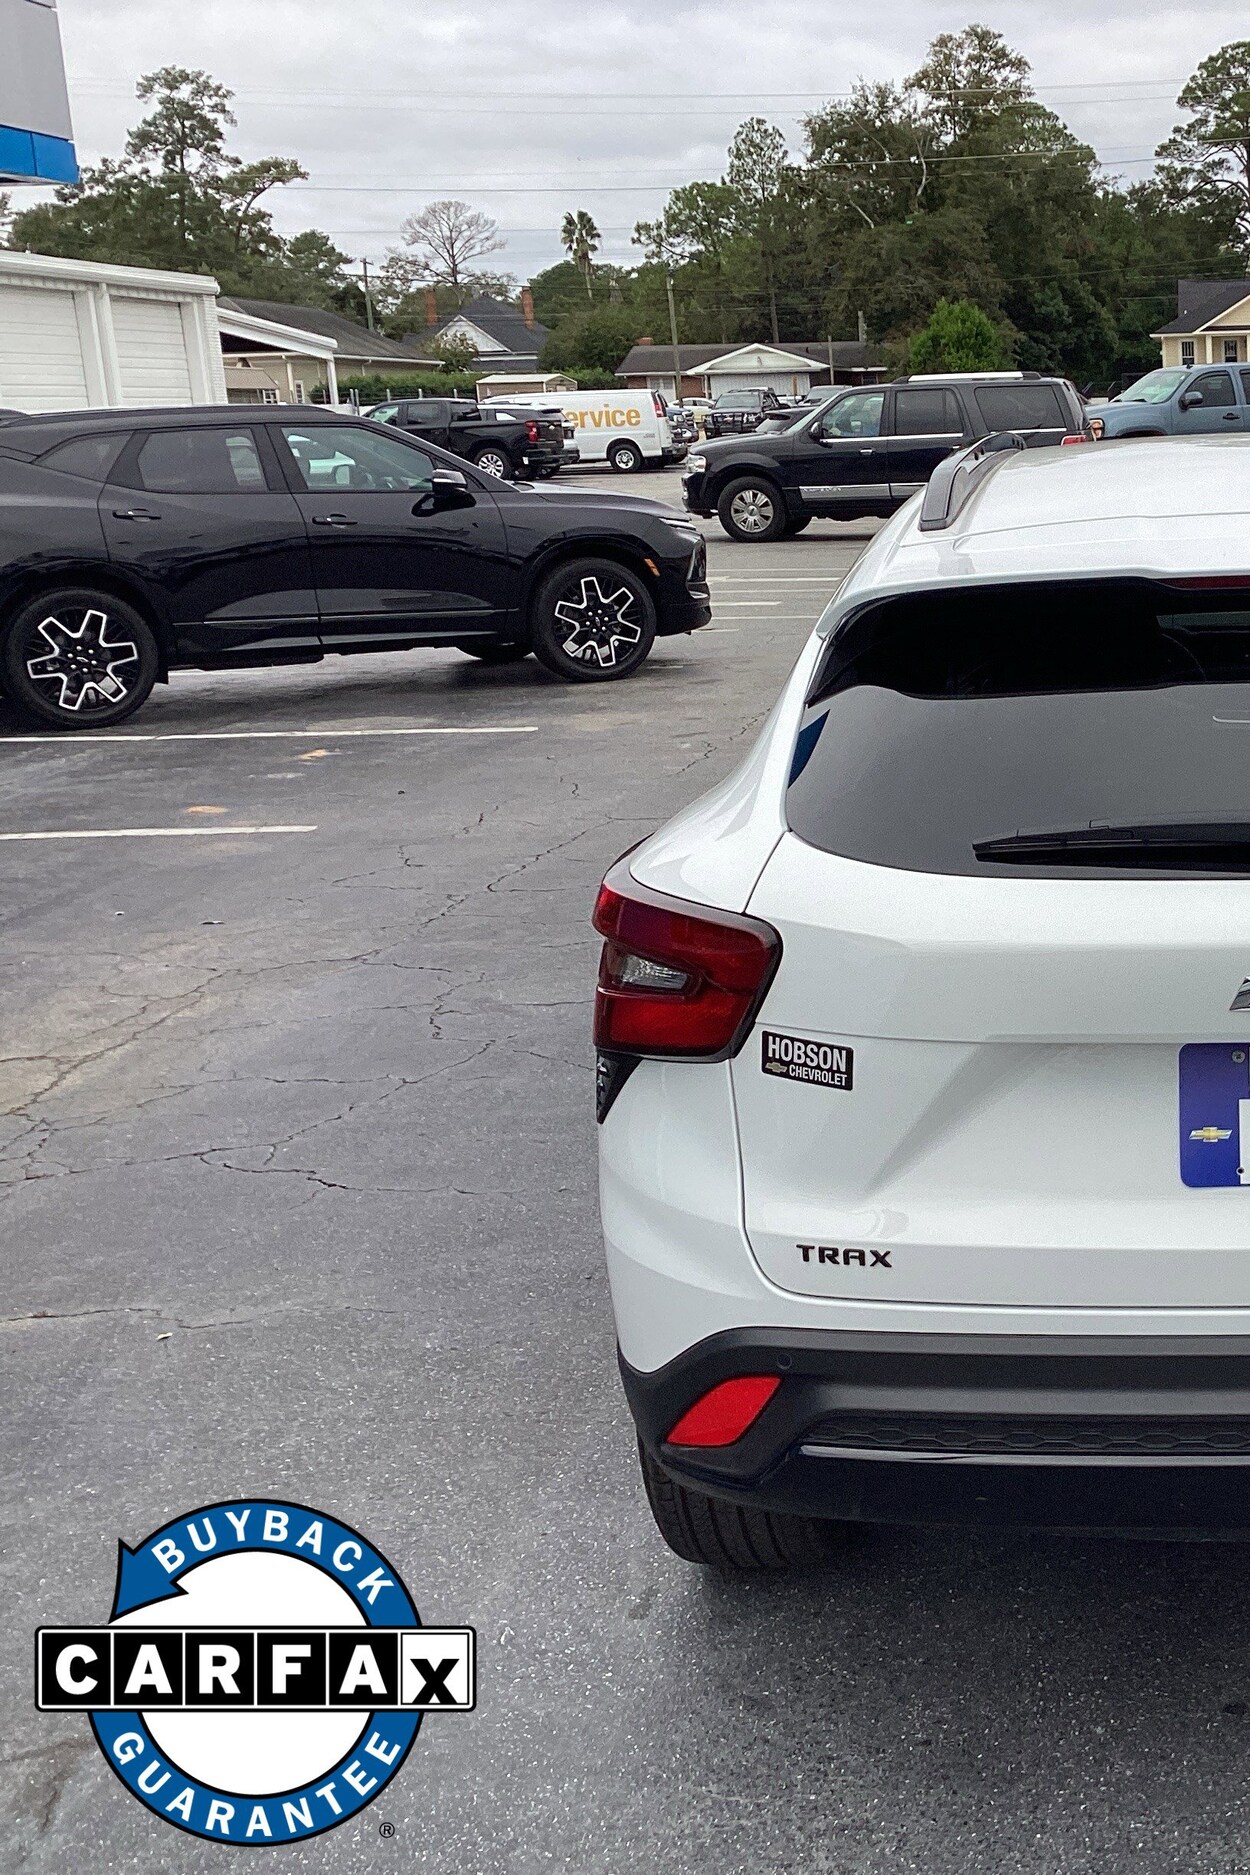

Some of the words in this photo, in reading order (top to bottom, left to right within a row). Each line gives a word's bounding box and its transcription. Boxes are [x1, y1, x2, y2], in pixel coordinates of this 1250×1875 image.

[564, 403, 641, 429] ervice
[767, 1035, 847, 1073] HOBSON
[789, 1064, 848, 1087] CHEVROLET
[796, 1244, 892, 1268] TRAX
